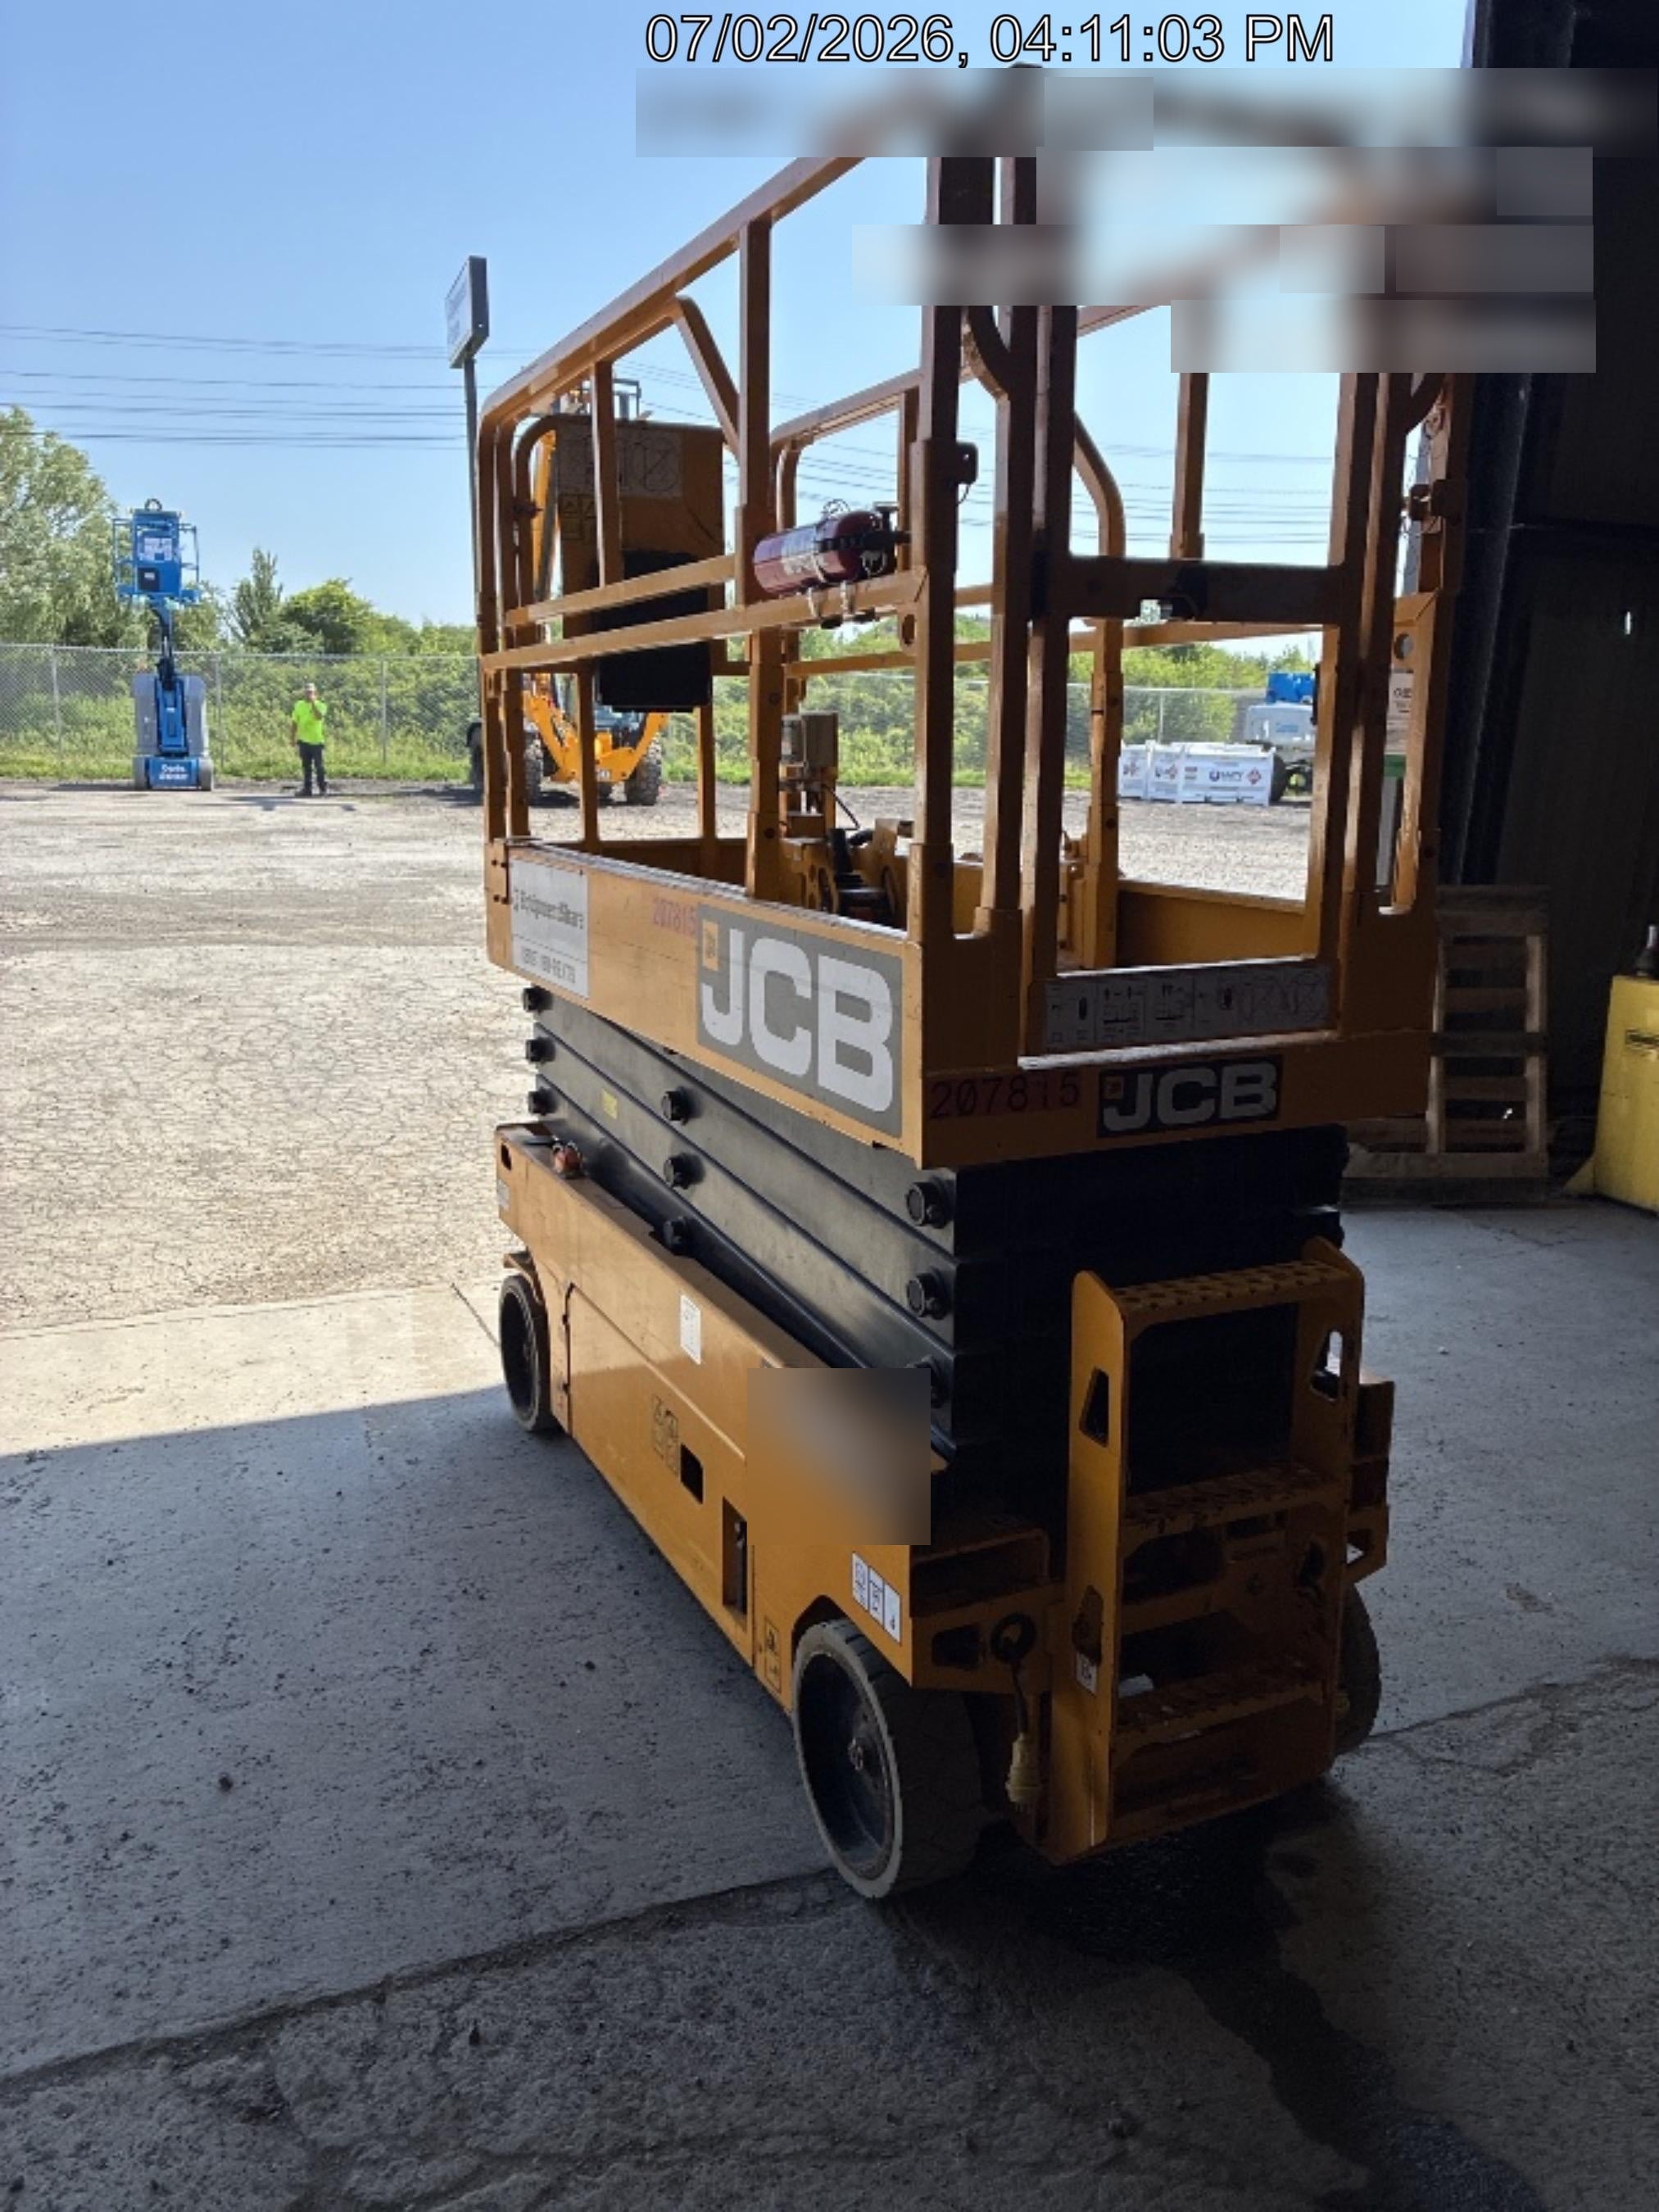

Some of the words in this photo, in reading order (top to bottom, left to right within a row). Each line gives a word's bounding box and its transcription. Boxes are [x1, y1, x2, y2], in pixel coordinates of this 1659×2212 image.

[702, 928, 893, 1113] JCB
[930, 1070, 1081, 1120] 207815
[1103, 1063, 1276, 1132] JCB
